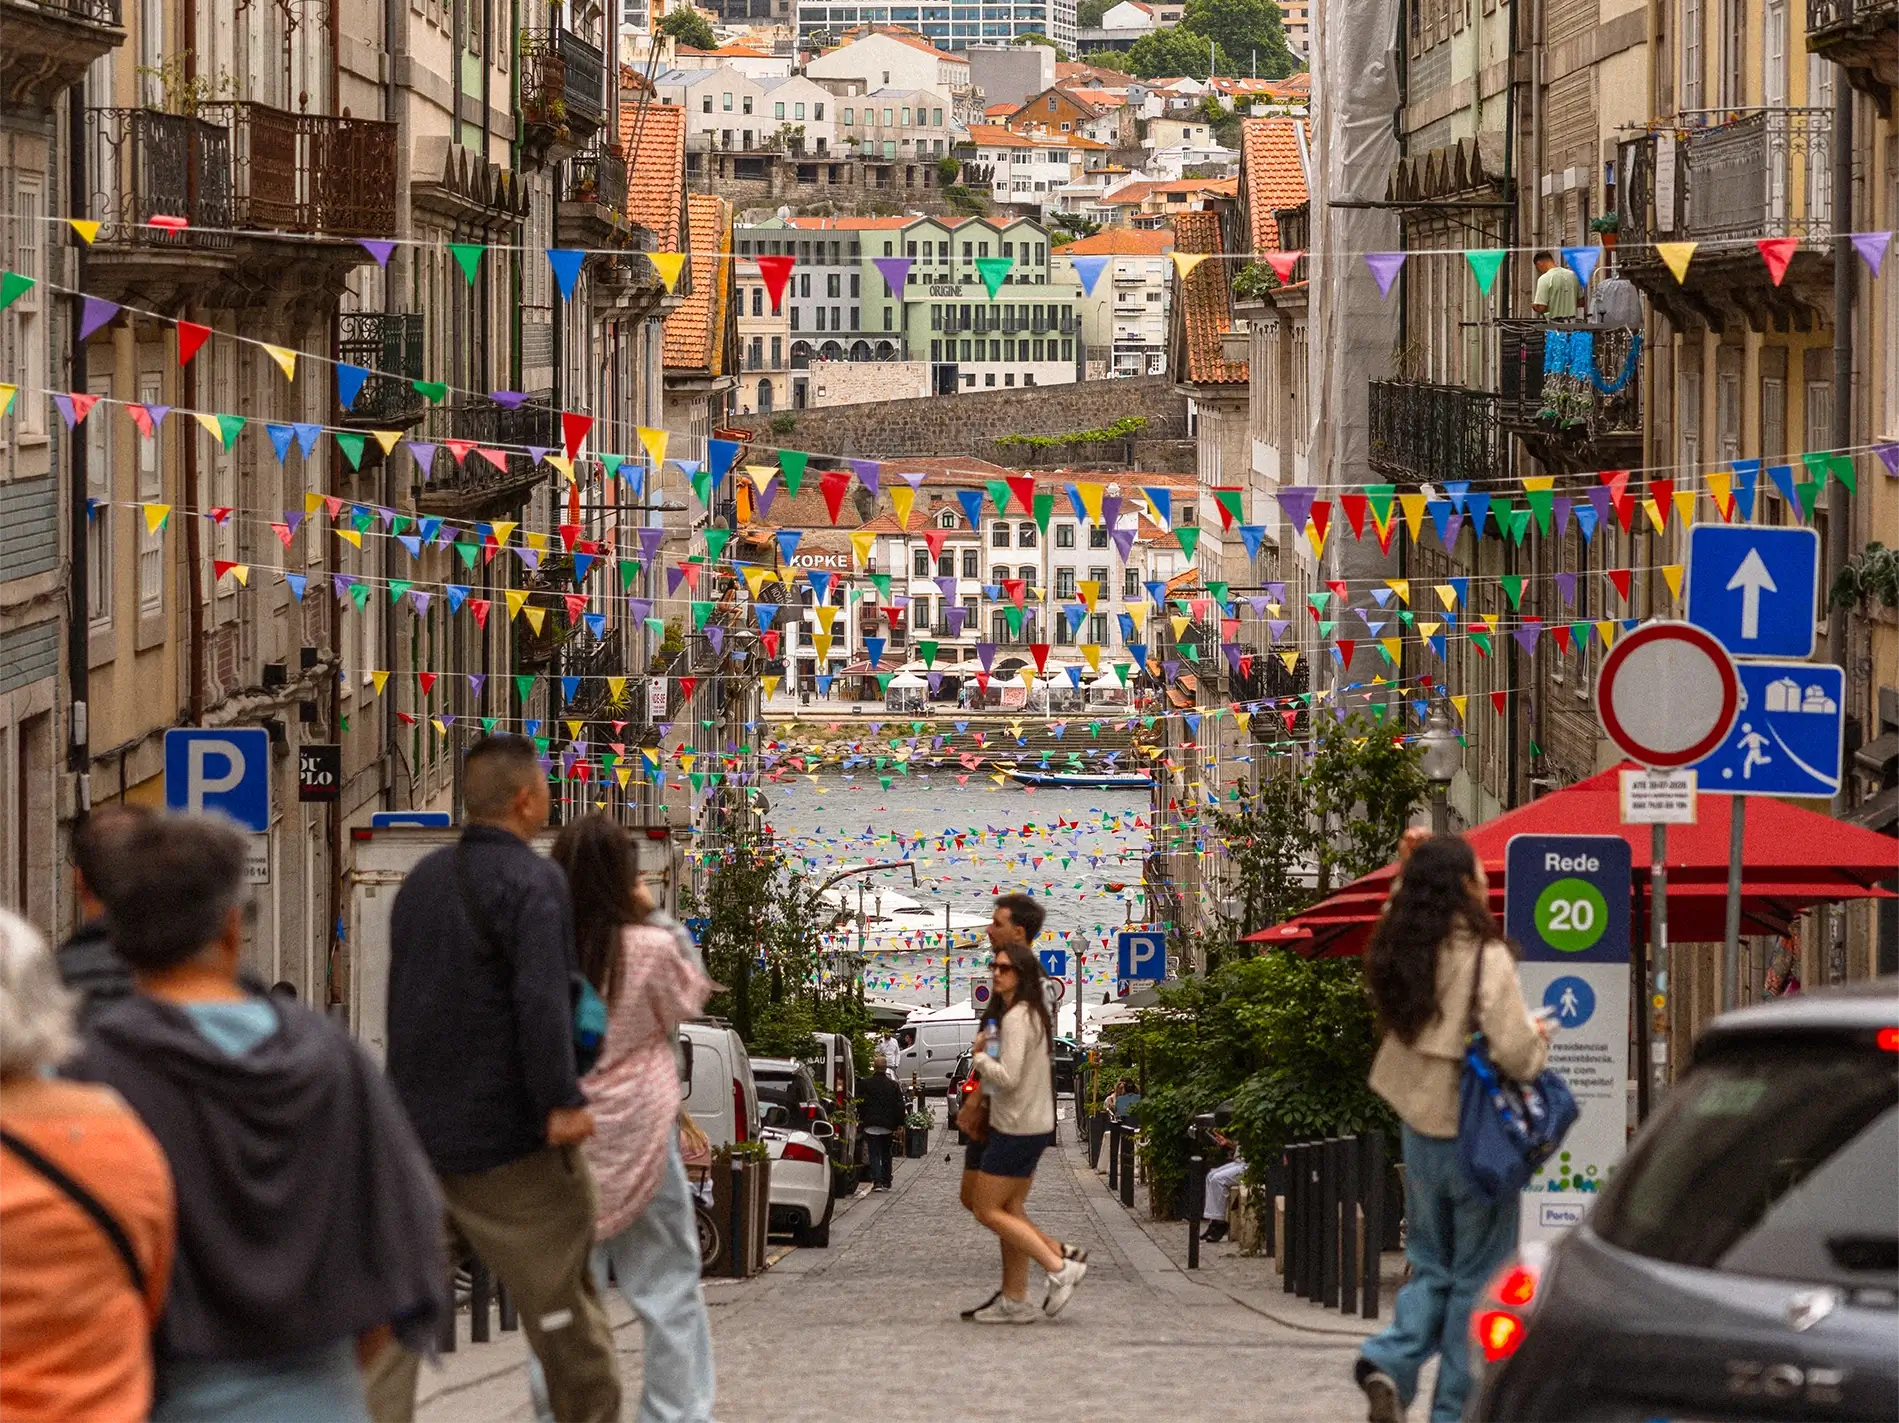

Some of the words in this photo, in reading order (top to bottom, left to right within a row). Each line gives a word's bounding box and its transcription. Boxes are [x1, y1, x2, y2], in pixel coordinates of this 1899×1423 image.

[929, 285, 963, 297] ORIGINE
[790, 555, 848, 567] KOPKE
[188, 739, 246, 819] P
[1545, 852, 1600, 872] Rede
[1548, 899, 1595, 931] 20
[1130, 937, 1155, 975] P
